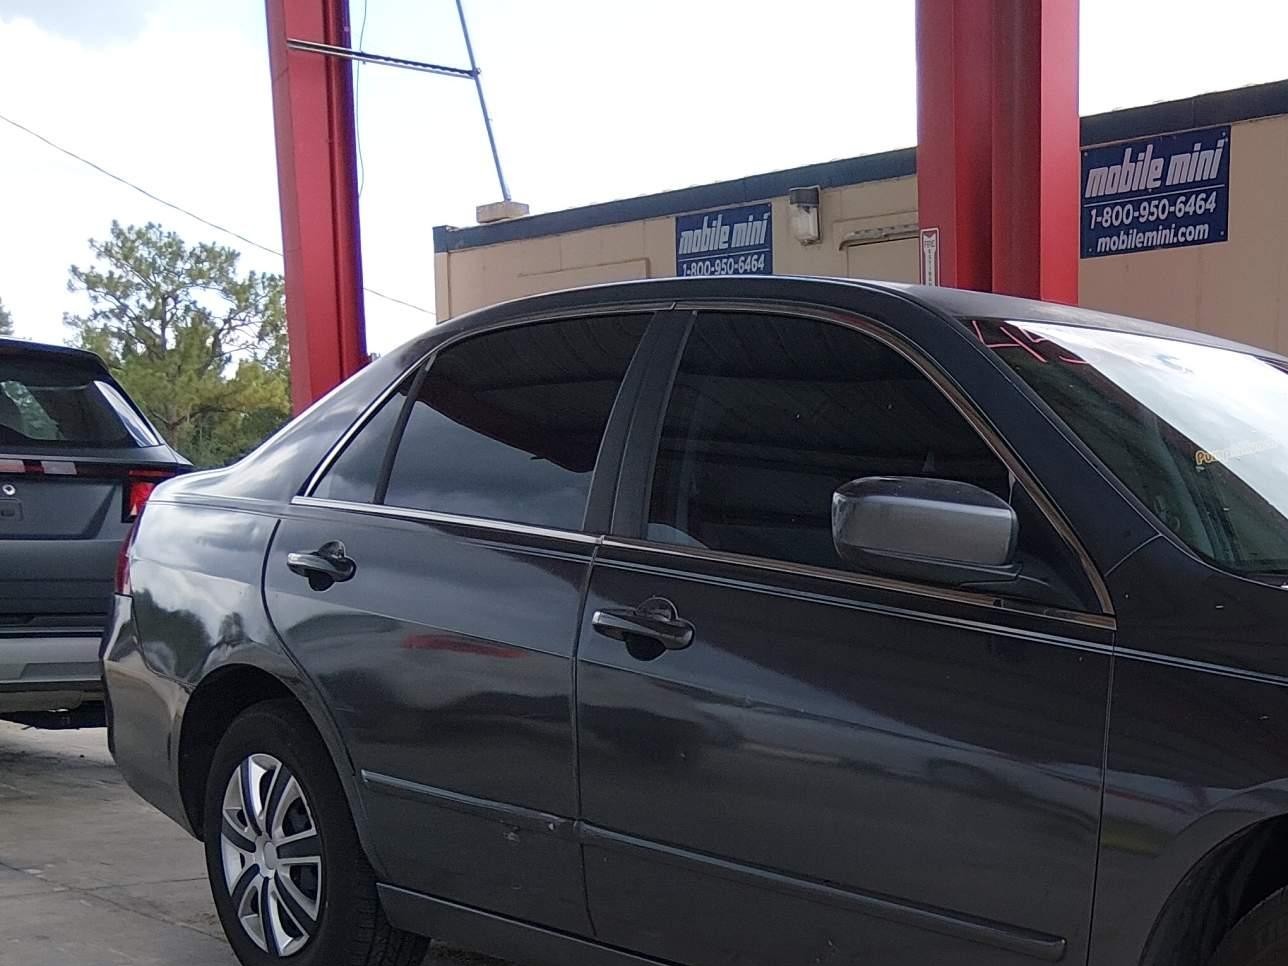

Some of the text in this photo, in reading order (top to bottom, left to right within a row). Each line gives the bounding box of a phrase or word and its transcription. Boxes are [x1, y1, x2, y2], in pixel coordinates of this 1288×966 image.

[1085, 139, 1225, 198] mobile mini
[1090, 191, 1216, 229] 1-800-950-6464
[679, 213, 769, 254] mobile mini
[1097, 224, 1209, 253] mobilemini.com
[682, 254, 765, 277] 1-800-950-6464
